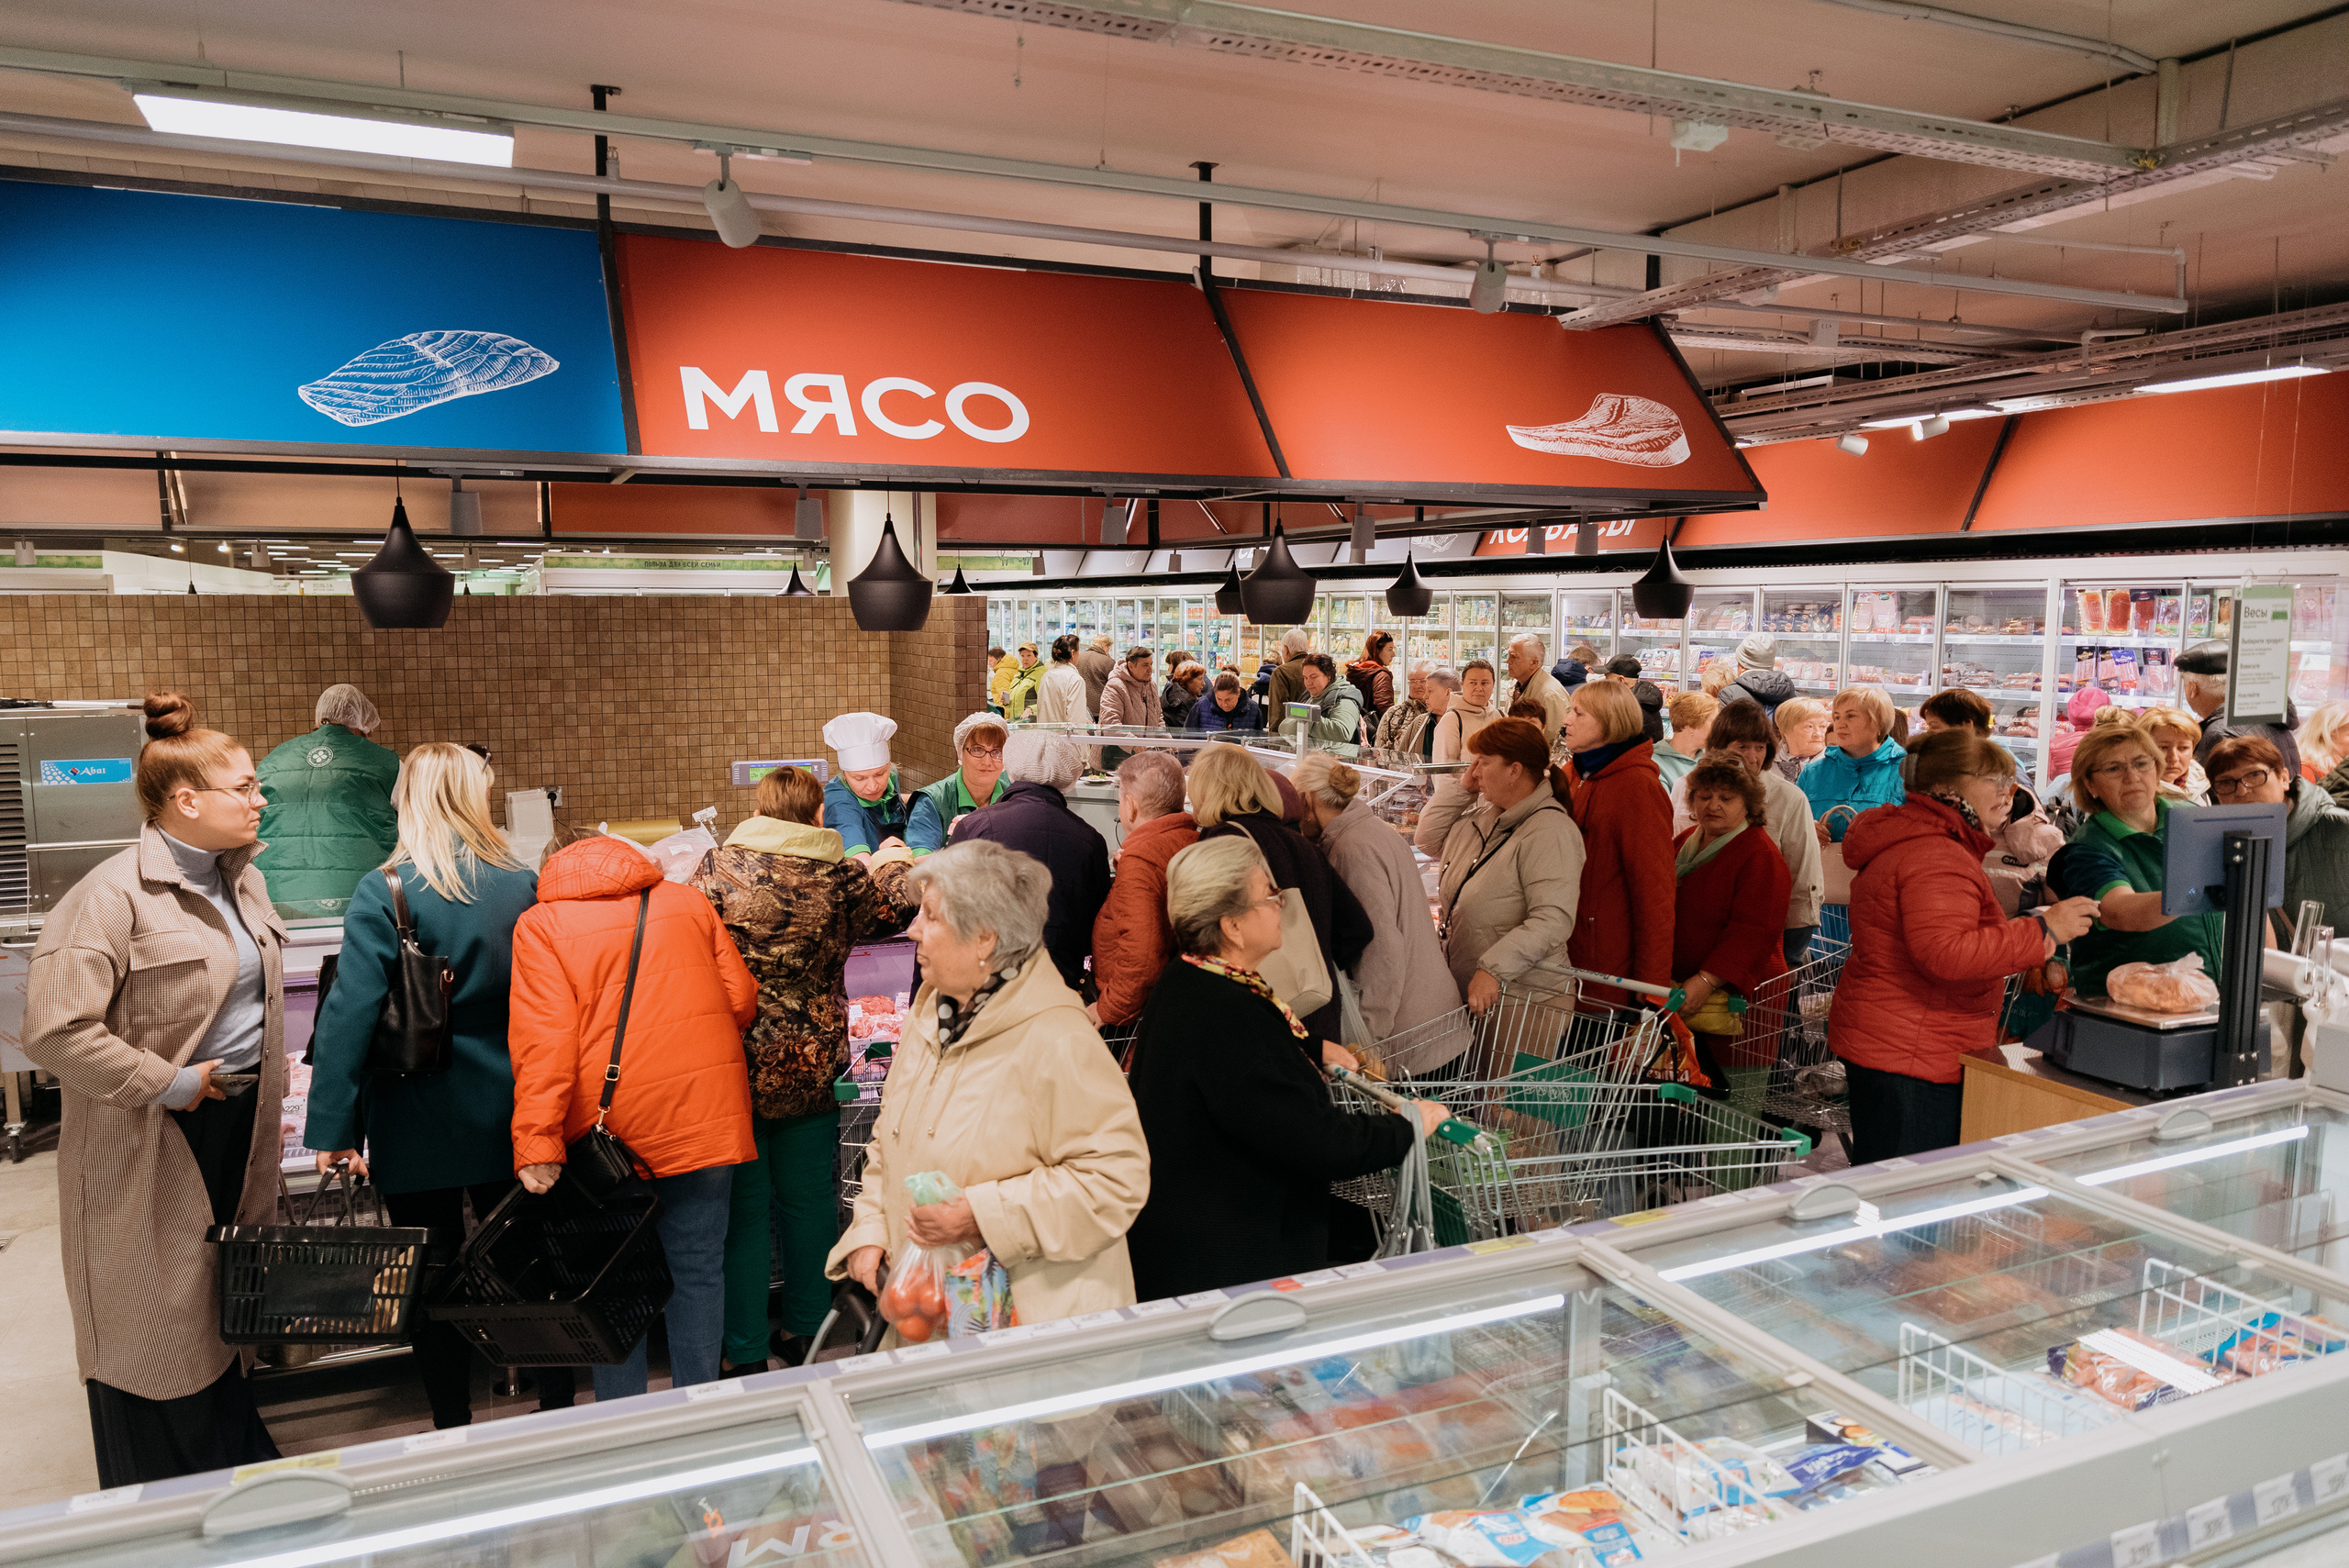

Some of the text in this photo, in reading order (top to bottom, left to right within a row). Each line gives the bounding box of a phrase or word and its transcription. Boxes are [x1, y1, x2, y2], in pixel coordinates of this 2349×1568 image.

[679, 366, 1030, 443] МЯСО
[2243, 606, 2267, 618] Весы
[80, 766, 106, 776] Abat
